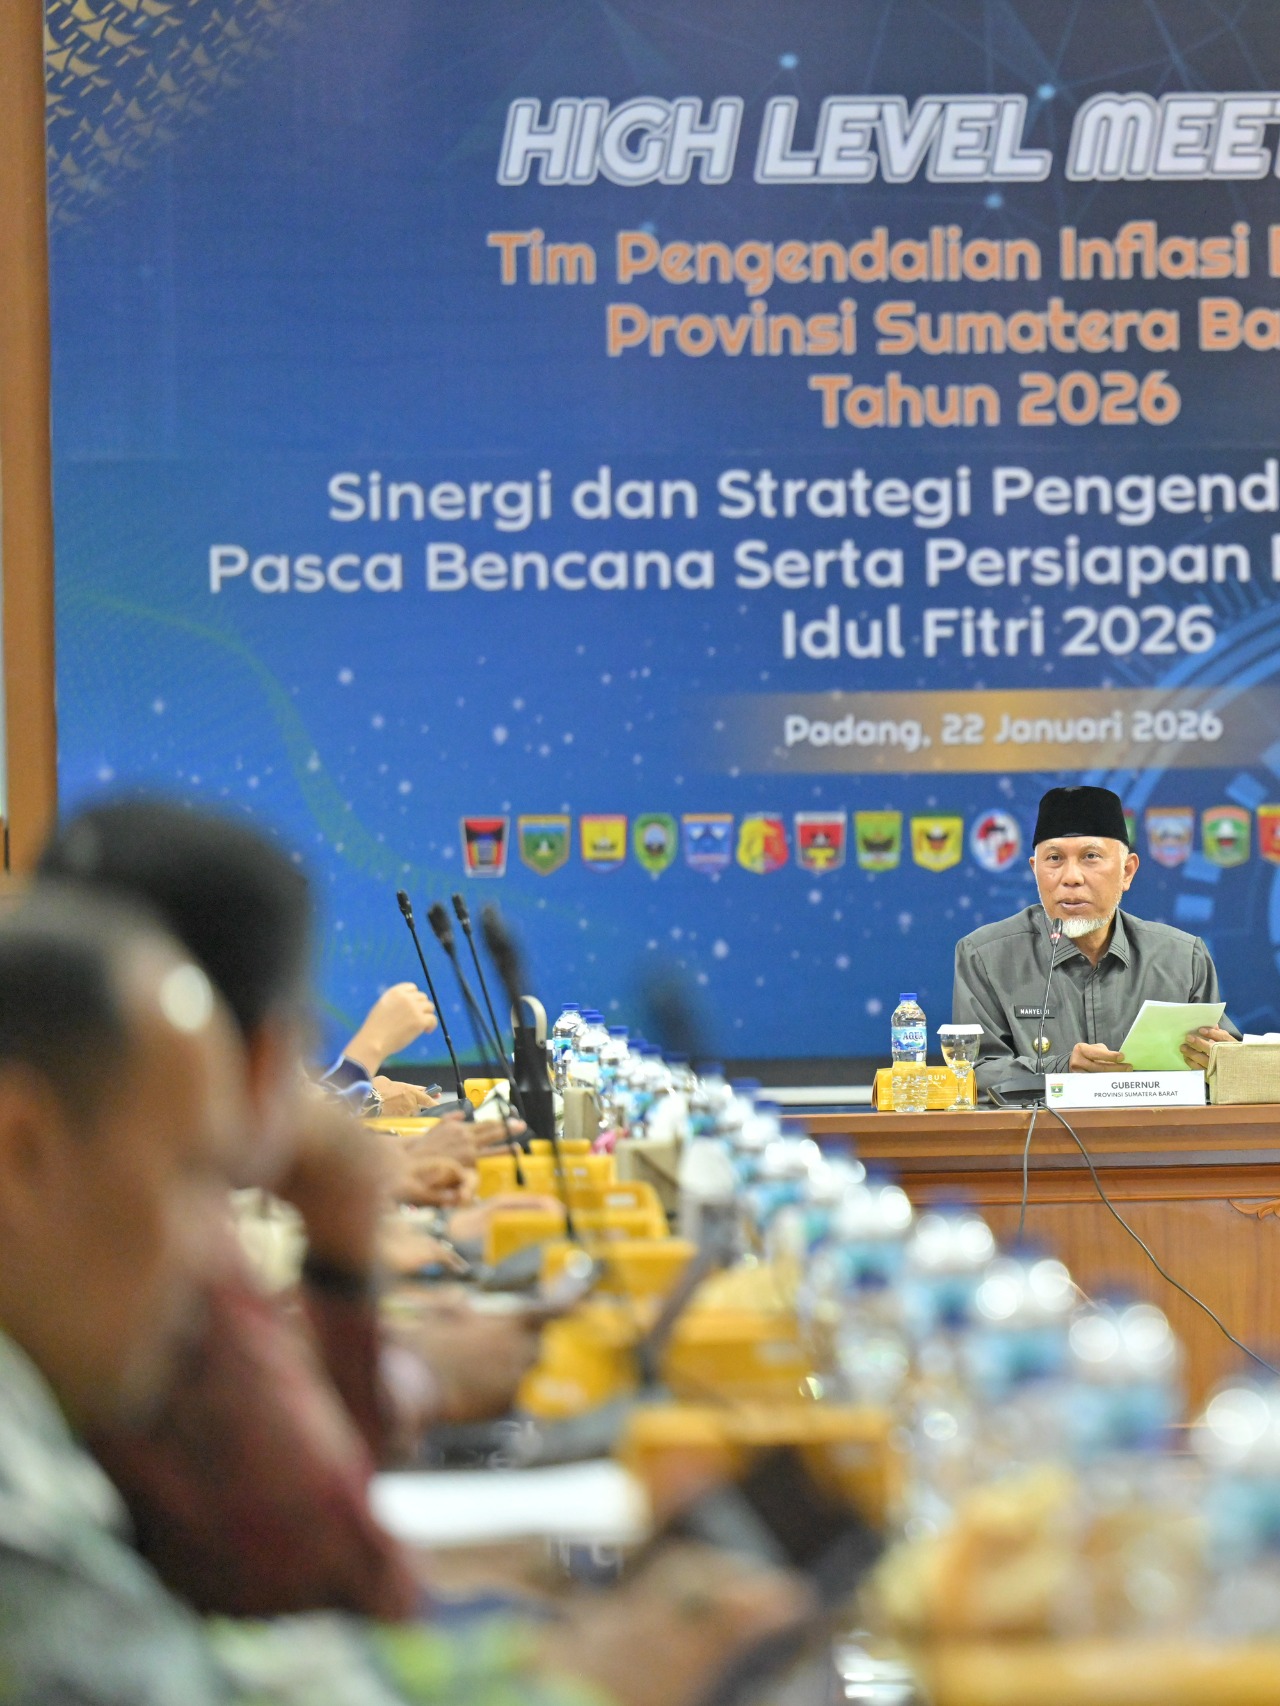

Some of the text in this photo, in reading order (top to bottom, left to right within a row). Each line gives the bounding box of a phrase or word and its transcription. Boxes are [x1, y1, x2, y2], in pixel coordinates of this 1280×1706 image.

[498, 97, 744, 186] HIGH
[754, 95, 1052, 184] LEVEL
[487, 229, 596, 284] Tim
[617, 225, 1041, 296] Pengendalian
[1061, 221, 1249, 280] Inflasi
[607, 299, 856, 356] Provinsi
[875, 297, 1179, 354] Sumatera
[809, 371, 1180, 428] Tahun 2026
[329, 470, 551, 531] Sinergi
[572, 466, 697, 519] dan
[718, 466, 970, 528] Strategi
[210, 545, 402, 592] Pasca
[427, 543, 714, 591] Bencana
[735, 540, 903, 589] Serta
[927, 535, 1250, 597] Persiapan
[783, 605, 1215, 658] Idul Fitri 2026
[786, 709, 1224, 752] Padang, 22 Januari 2026
[902, 1031, 924, 1041] AQUA
[1110, 1081, 1161, 1090] GUBERNUR
